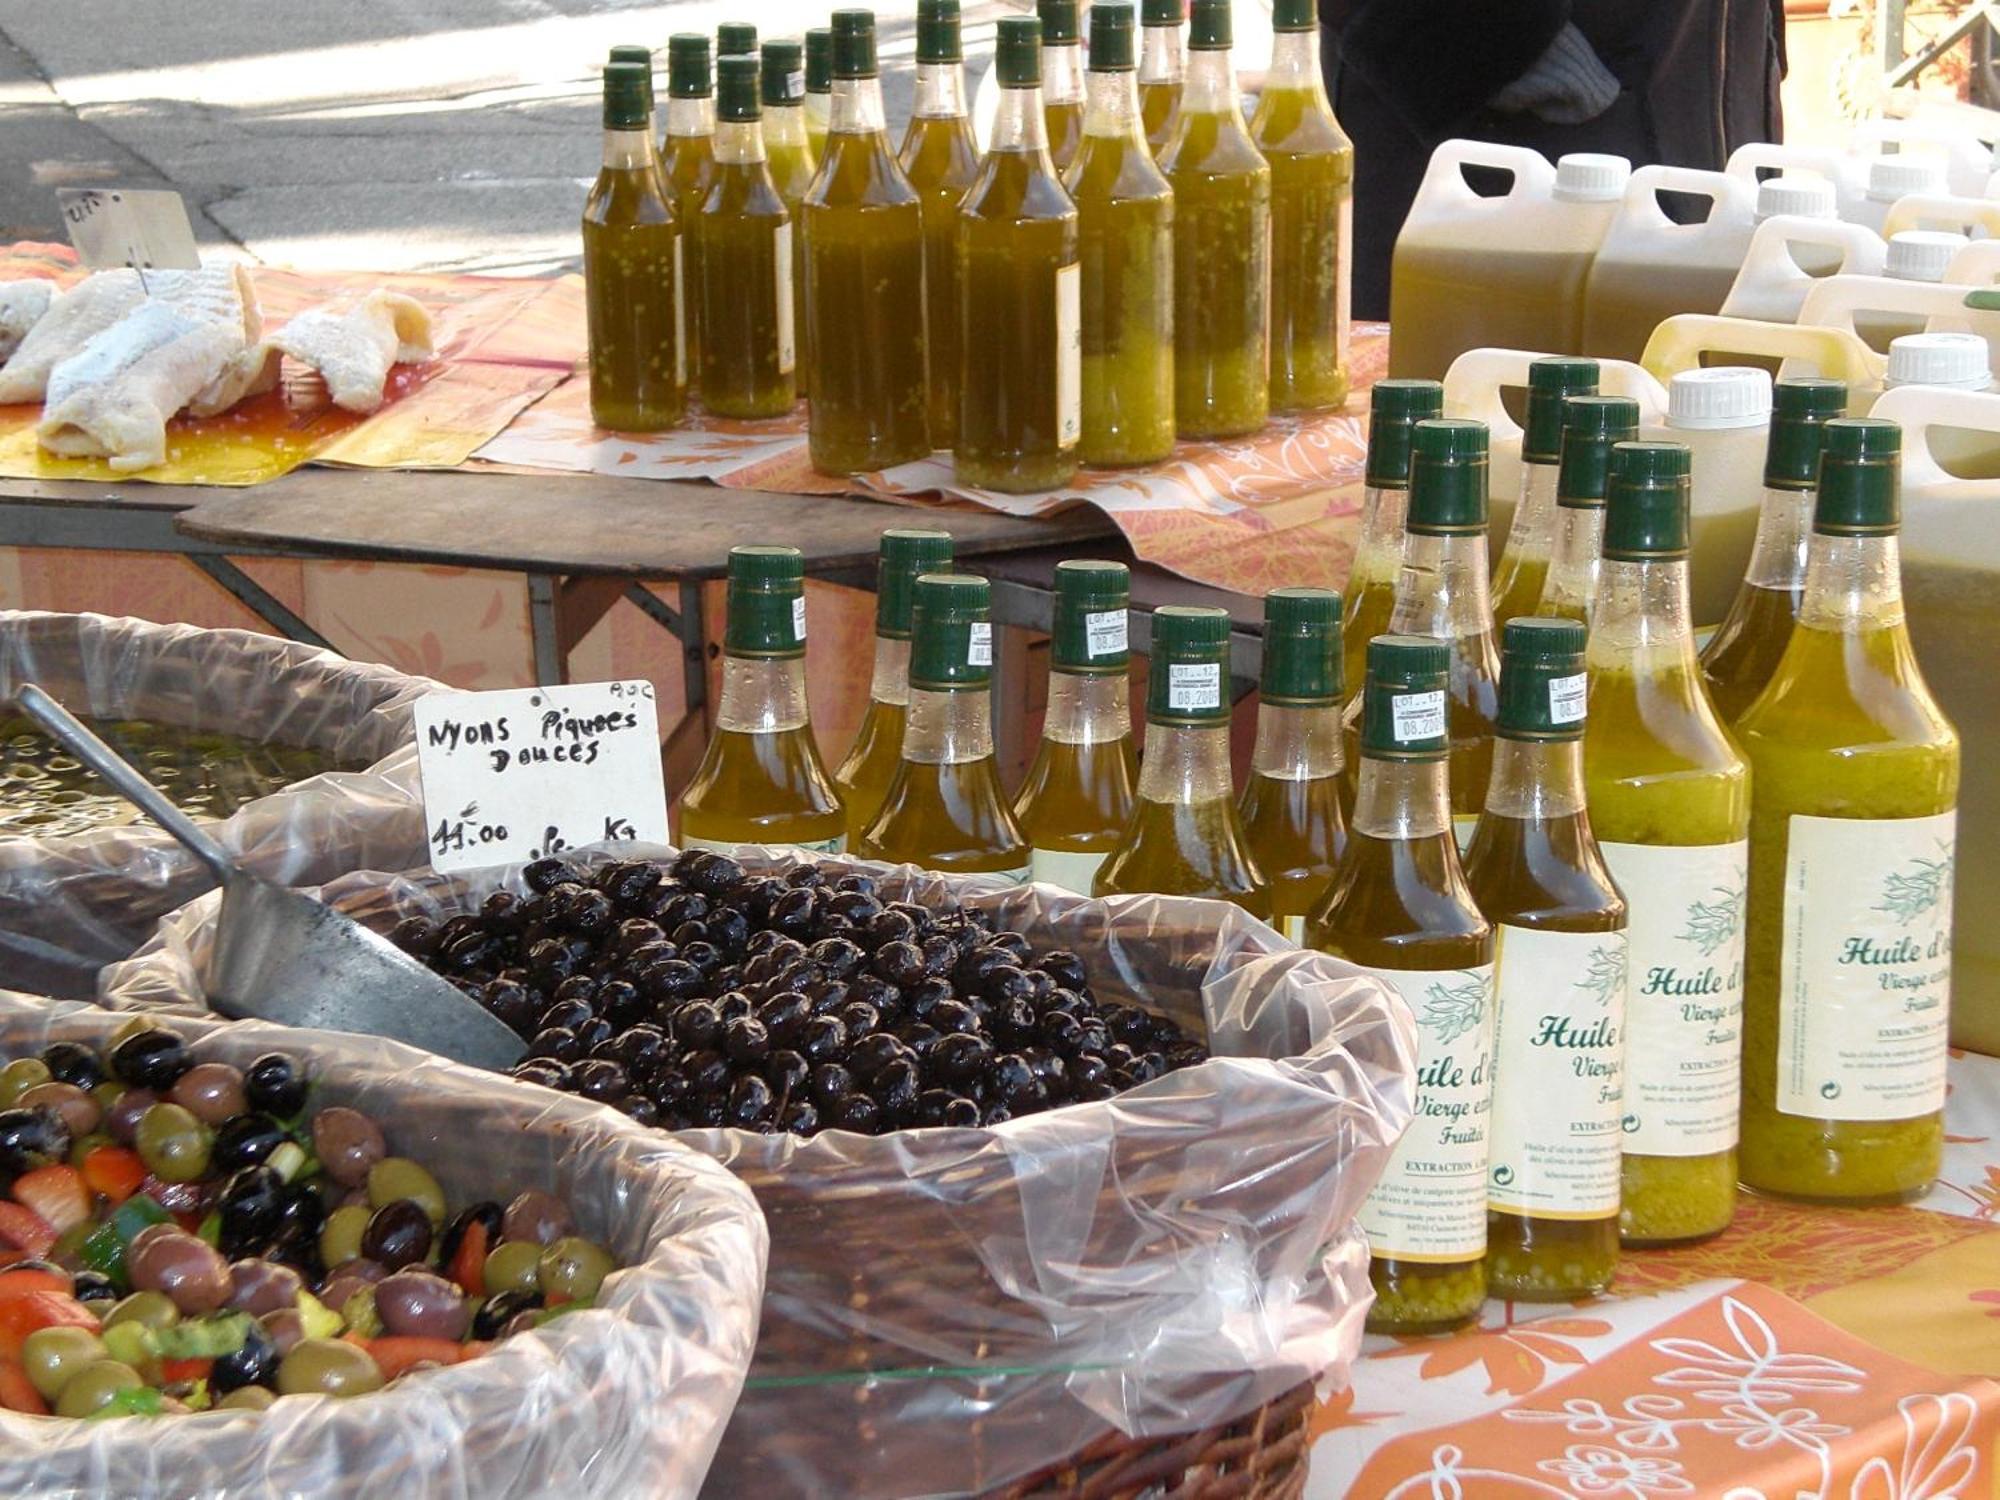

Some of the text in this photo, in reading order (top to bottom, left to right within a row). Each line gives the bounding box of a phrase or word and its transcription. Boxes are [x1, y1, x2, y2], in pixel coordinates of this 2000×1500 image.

[1838, 936, 1921, 965] Huile
[1641, 966, 1722, 995] Huile
[1530, 1015, 1617, 1048] Huile
[1413, 1094, 1470, 1124] Vierge
[1405, 1160, 1473, 1173] EXTRACTION
